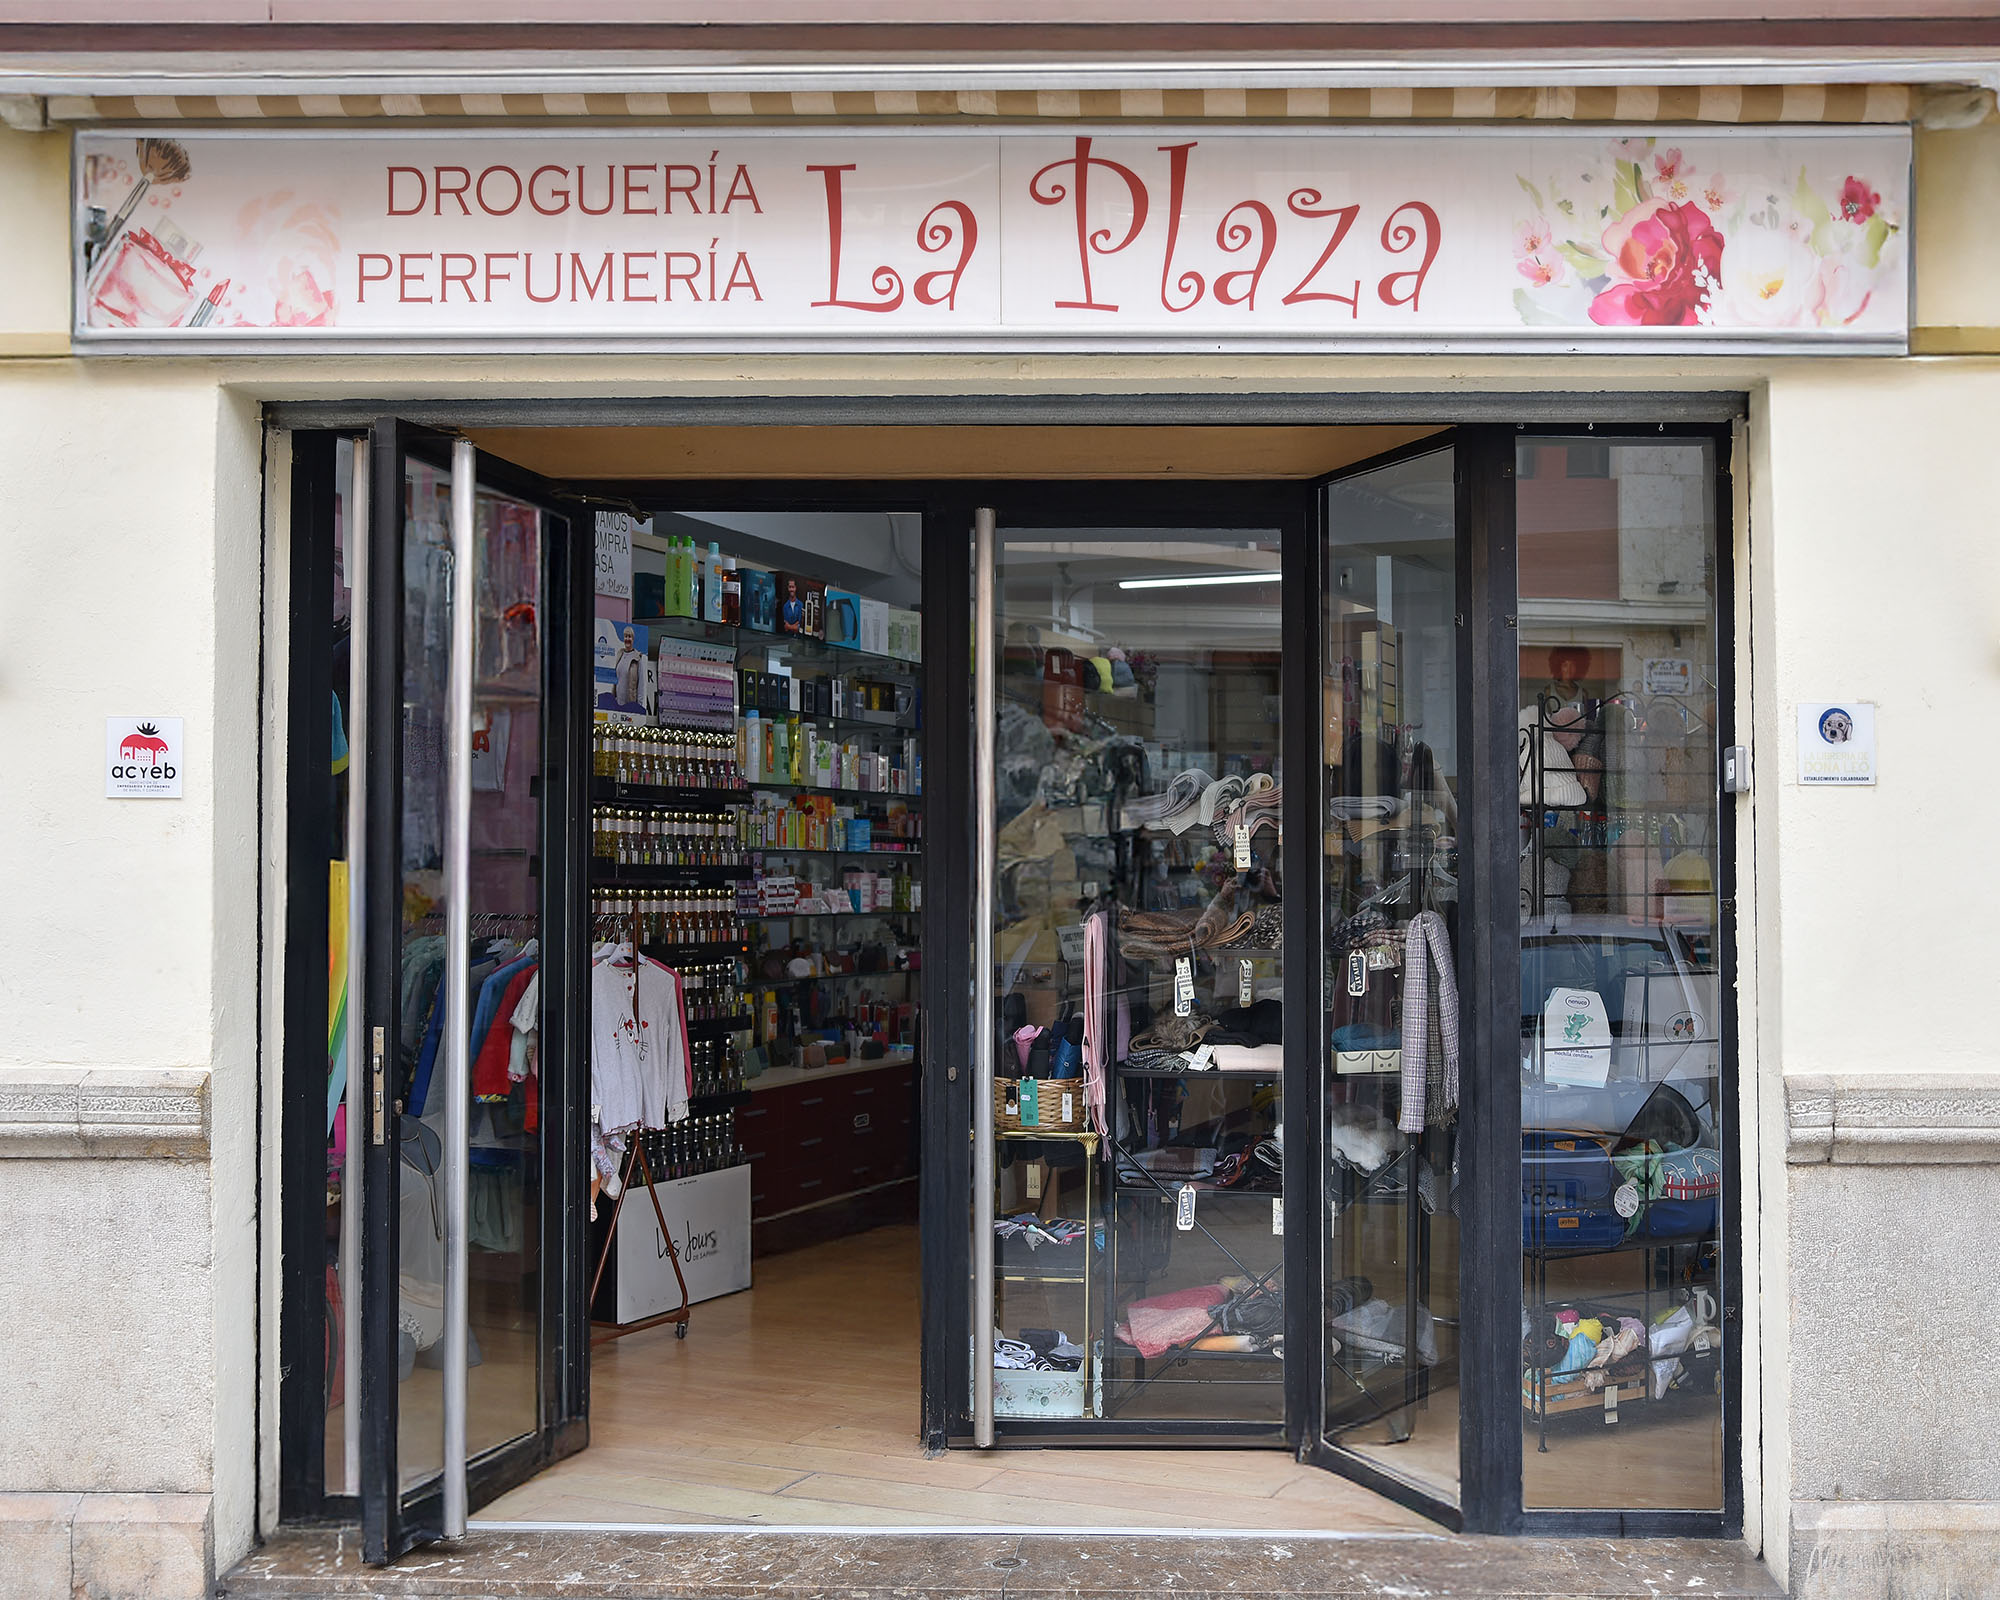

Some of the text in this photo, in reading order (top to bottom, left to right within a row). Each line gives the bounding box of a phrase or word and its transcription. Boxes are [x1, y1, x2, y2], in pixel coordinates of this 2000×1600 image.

[386, 150, 764, 217] DROGUERÍA
[805, 136, 1442, 319] La Plaza
[356, 237, 764, 304] PERFUMERÍA
[1177, 966, 1190, 975] 73
[1182, 1193, 1192, 1225] PRIVATA
